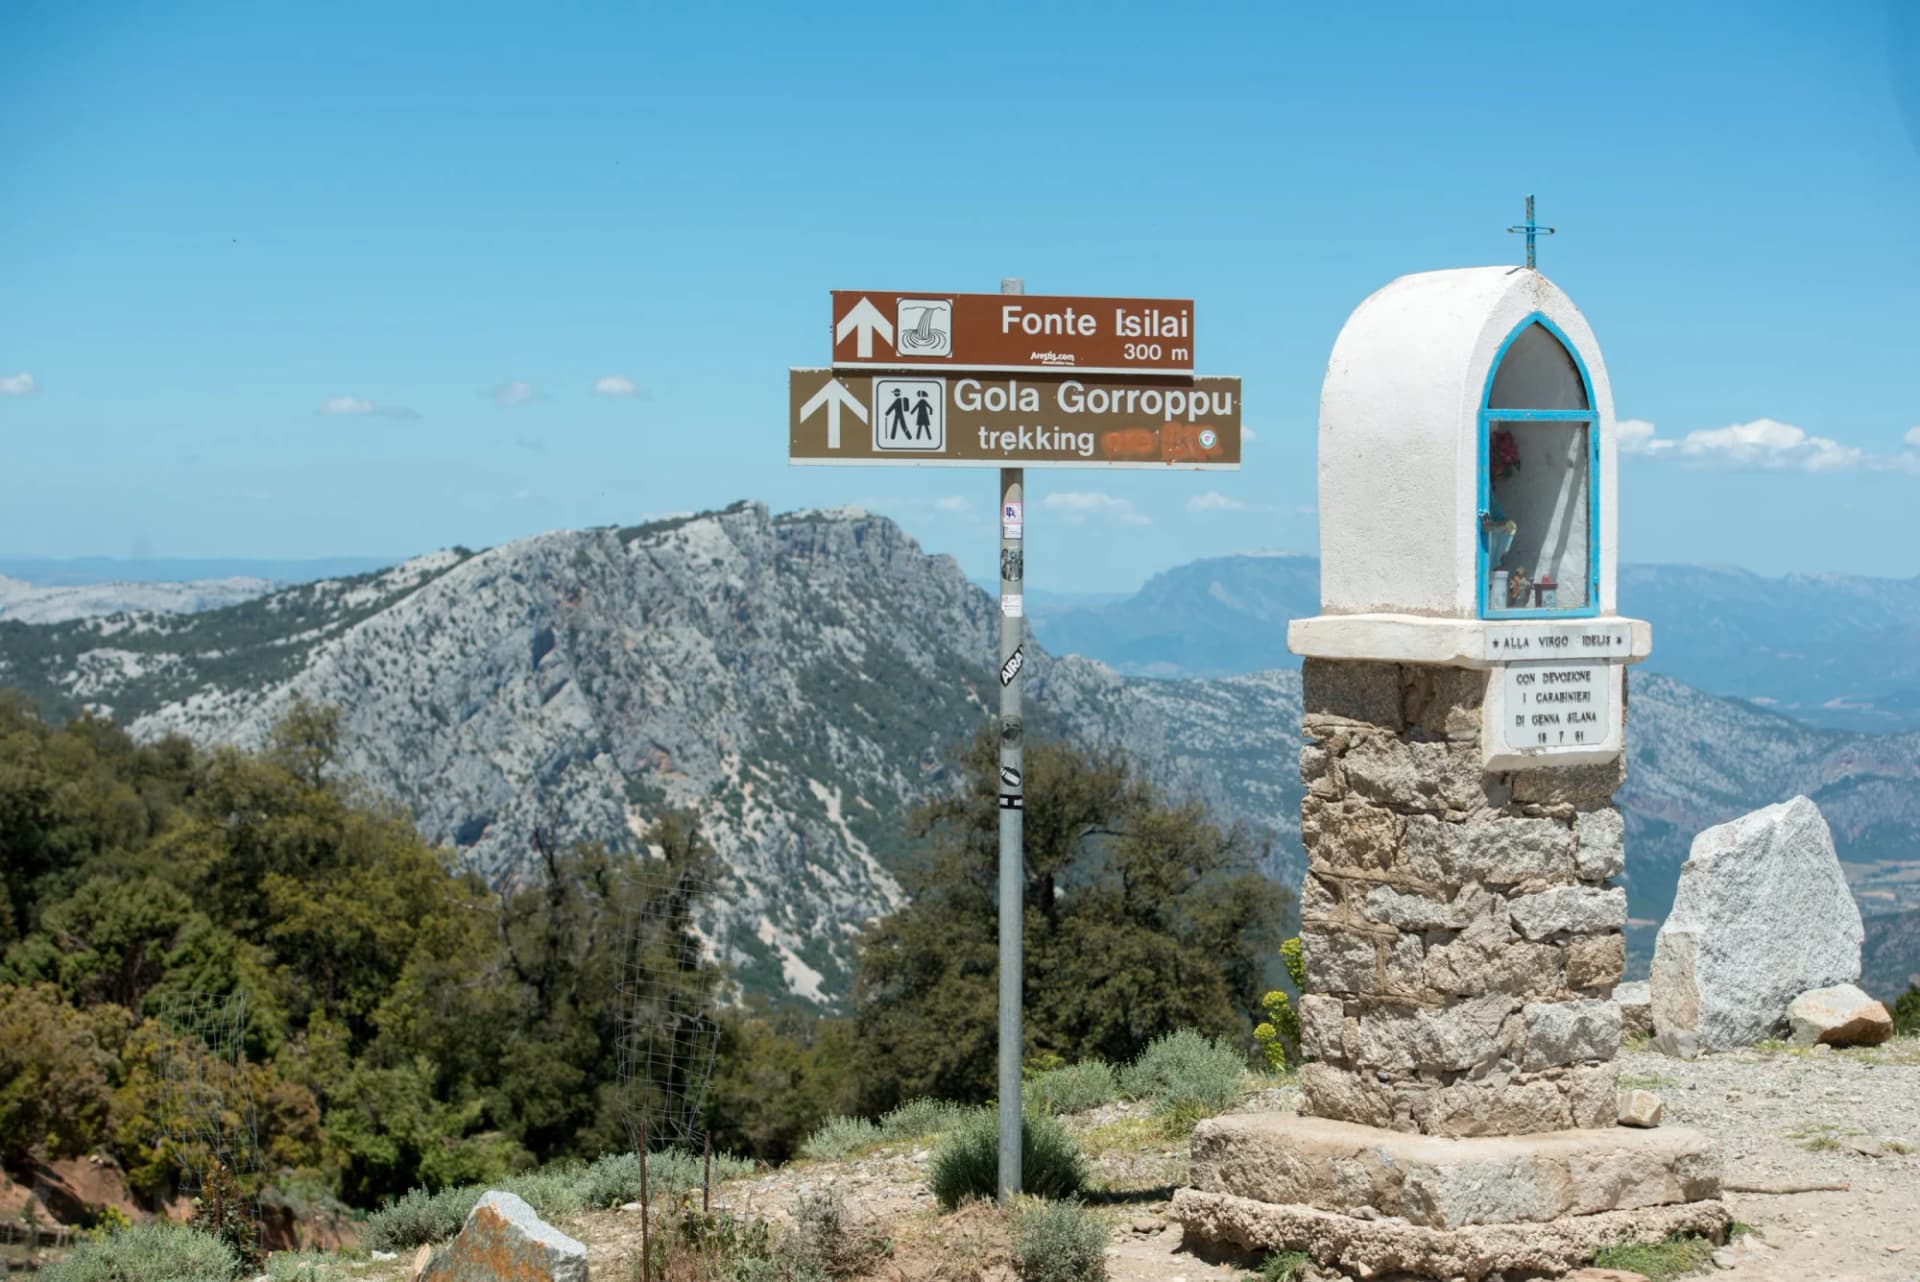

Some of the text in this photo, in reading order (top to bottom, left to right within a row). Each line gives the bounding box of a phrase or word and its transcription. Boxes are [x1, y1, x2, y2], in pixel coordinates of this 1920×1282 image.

[1002, 305, 1189, 339] Fonte Isilai
[1124, 343, 1189, 361] 300 m
[953, 379, 1233, 422] Gola Gorroppu
[978, 426, 1095, 457] trekking
[1504, 637, 1529, 649] ALLA
[1538, 635, 1569, 648] VIRGO
[1516, 671, 1591, 685] CON DEVOZIONE
[1536, 691, 1591, 703] CARABINIERI
[1516, 712, 1596, 727] DI GENNA SILANA
[1559, 731, 1564, 742] 7
